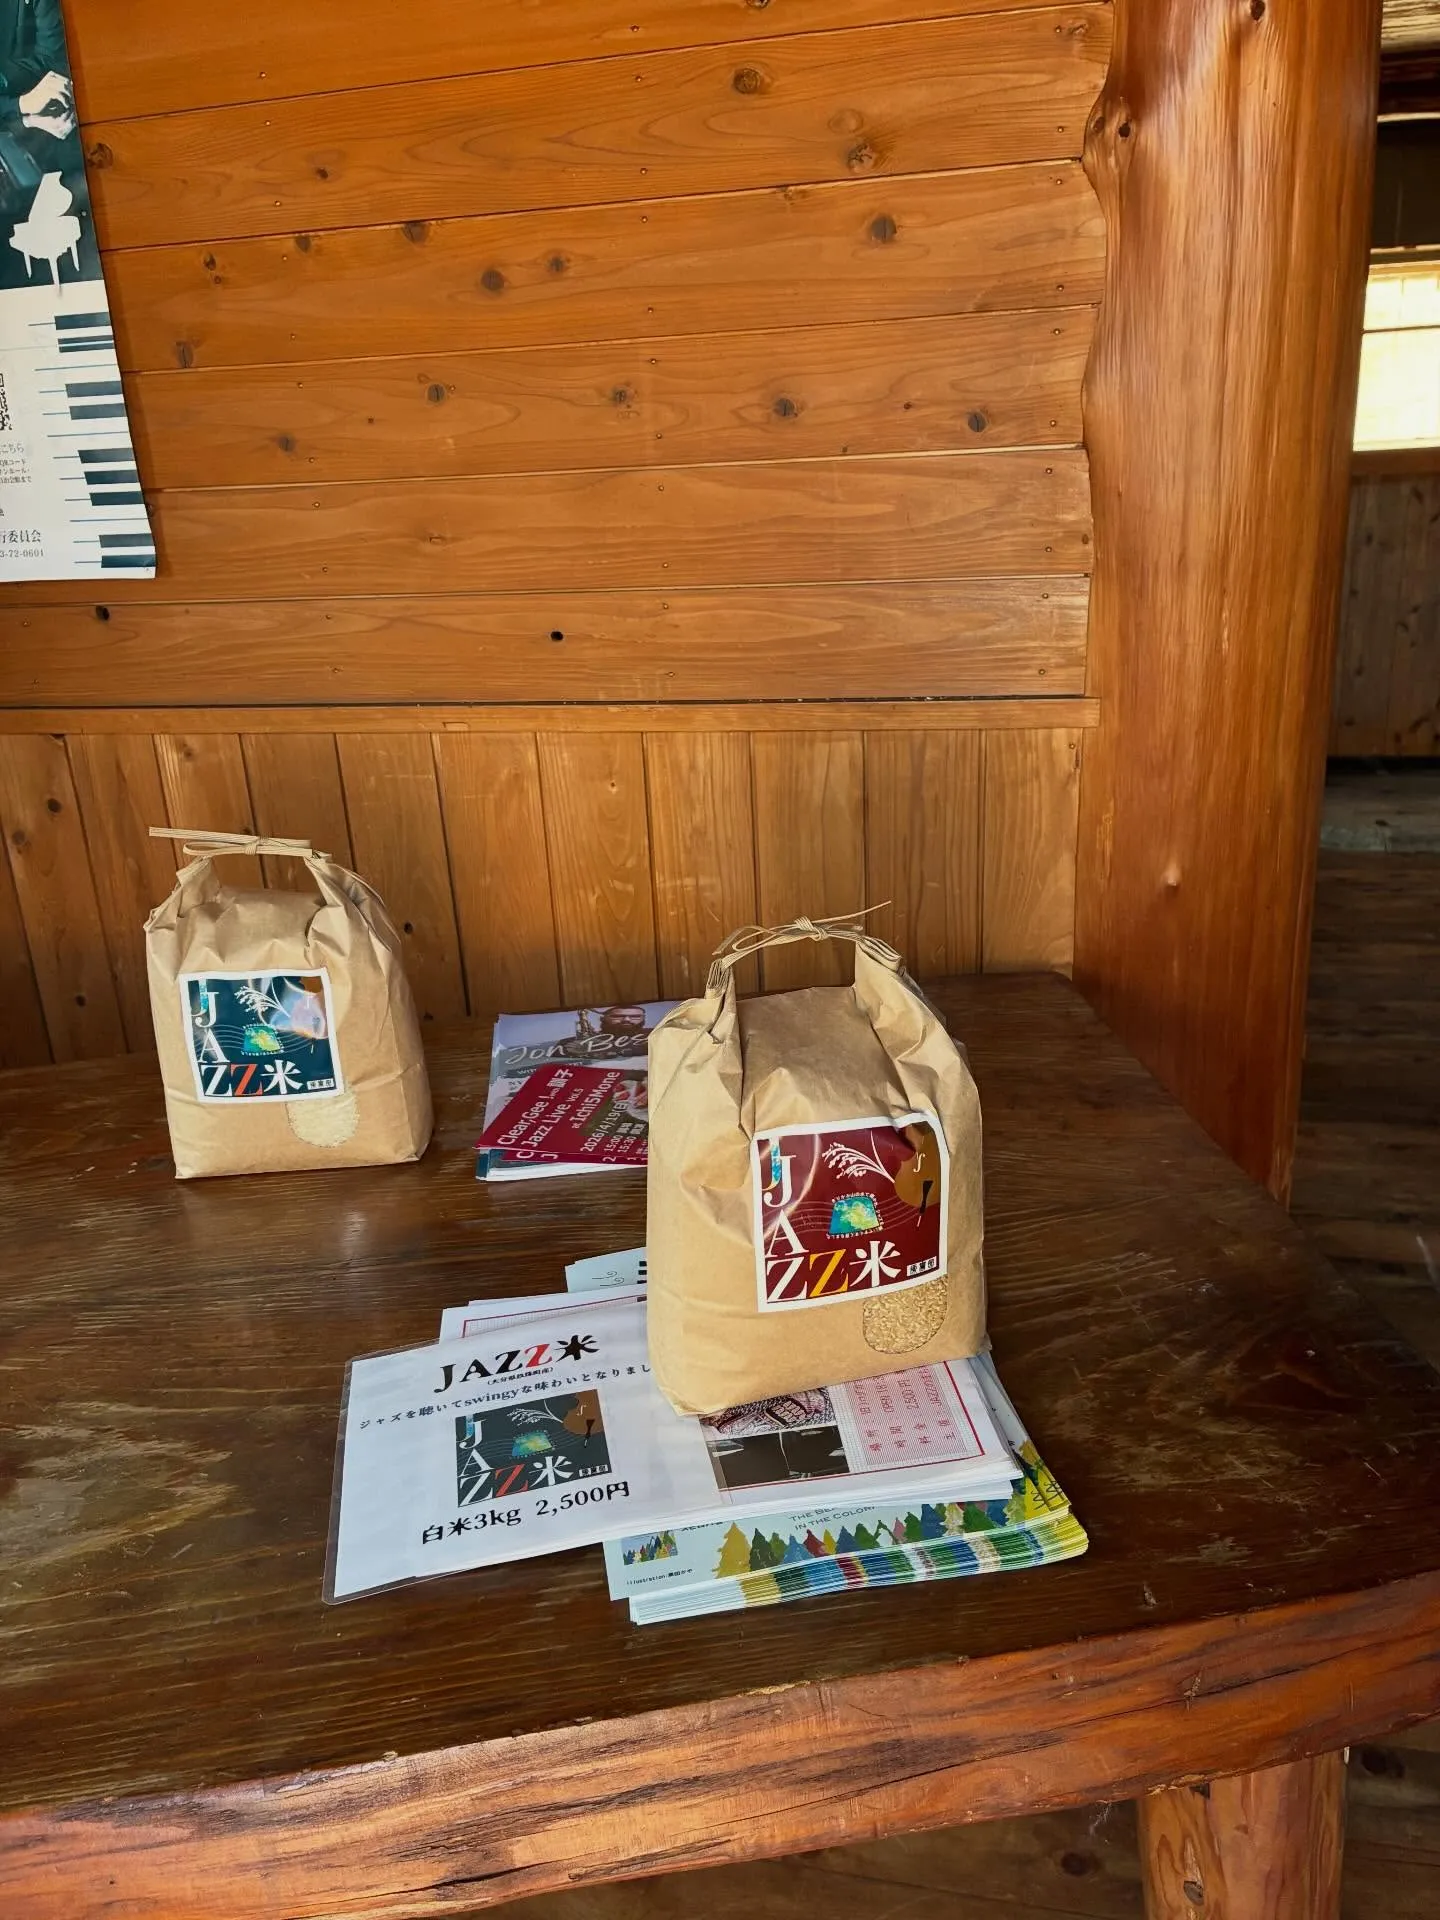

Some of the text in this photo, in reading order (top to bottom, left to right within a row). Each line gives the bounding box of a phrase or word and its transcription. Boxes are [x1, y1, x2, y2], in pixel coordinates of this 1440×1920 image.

[505, 1045, 566, 1065] Jon
[521, 1125, 553, 1147] Jazz
[541, 1103, 571, 1123] Live
[434, 1334, 601, 1393] JAZZ米
[422, 1481, 631, 1545] 白米3kg 2,500円
